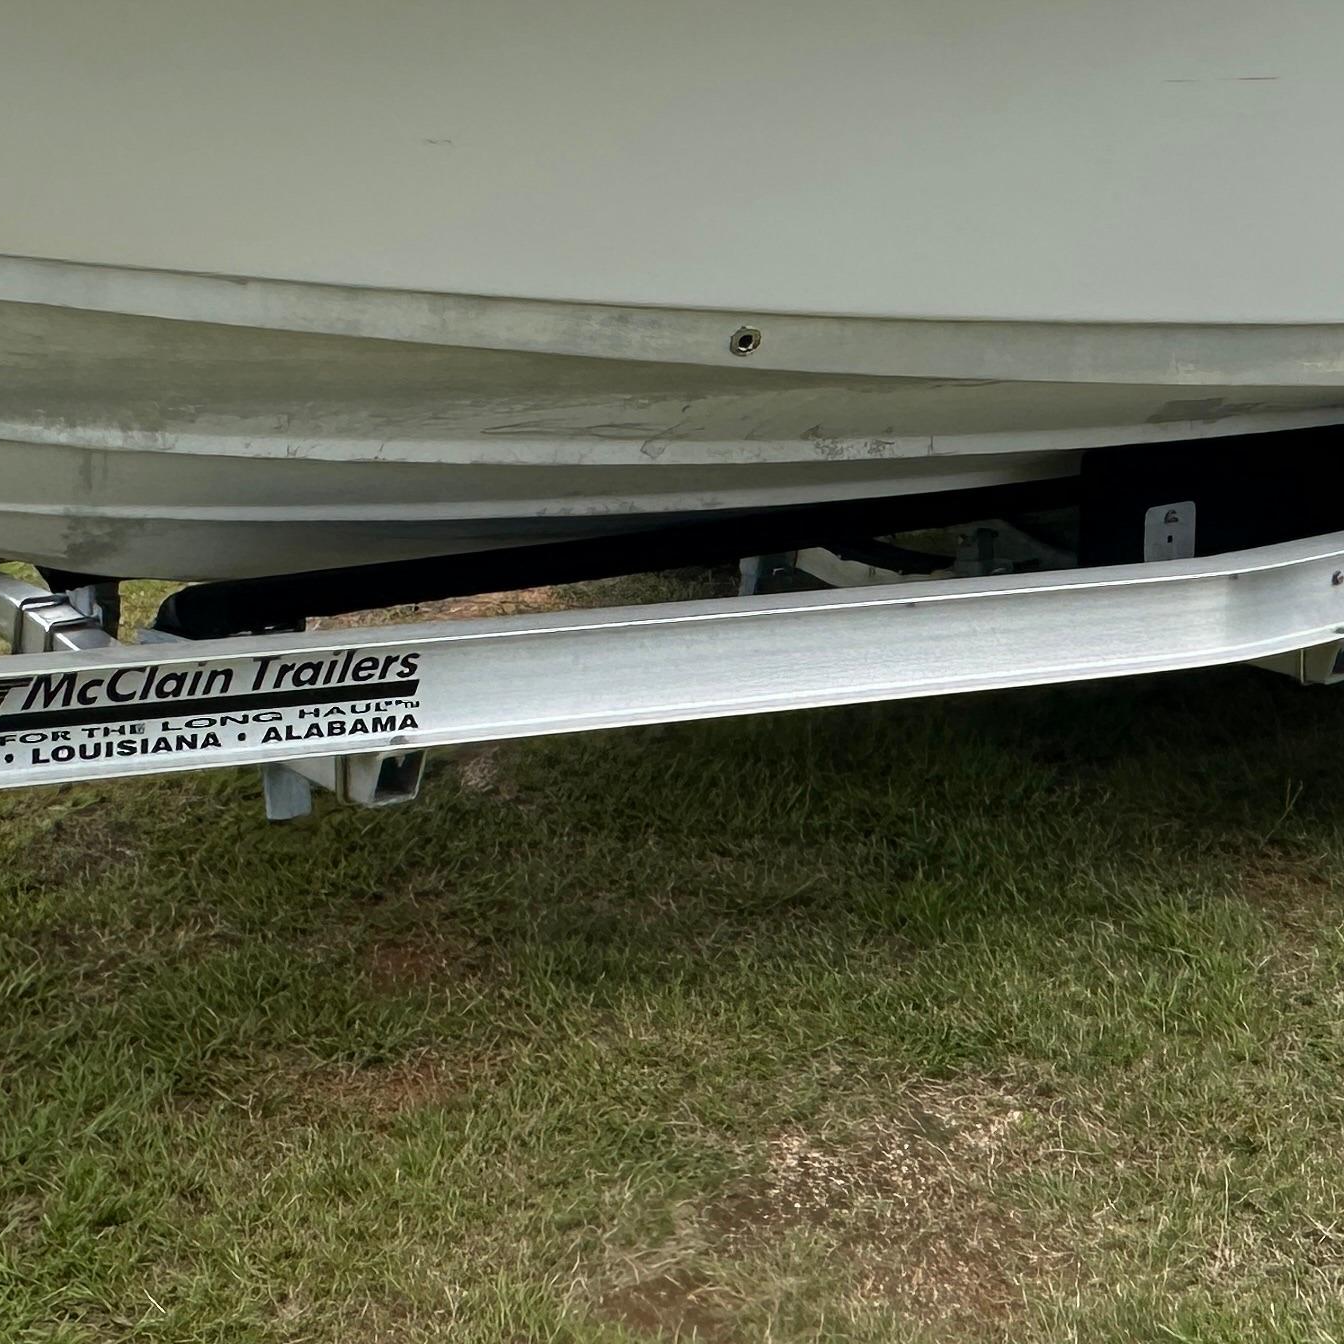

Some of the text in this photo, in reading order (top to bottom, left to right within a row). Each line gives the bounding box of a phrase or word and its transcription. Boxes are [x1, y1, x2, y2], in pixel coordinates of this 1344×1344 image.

[21, 659, 234, 711] McClain
[252, 649, 421, 692] Trailers
[0, 730, 71, 747] FOR
[81, 721, 146, 739] THE
[161, 711, 283, 732] LONG
[31, 732, 222, 765] LOUISIANA
[261, 713, 419, 744] ALABAMA
